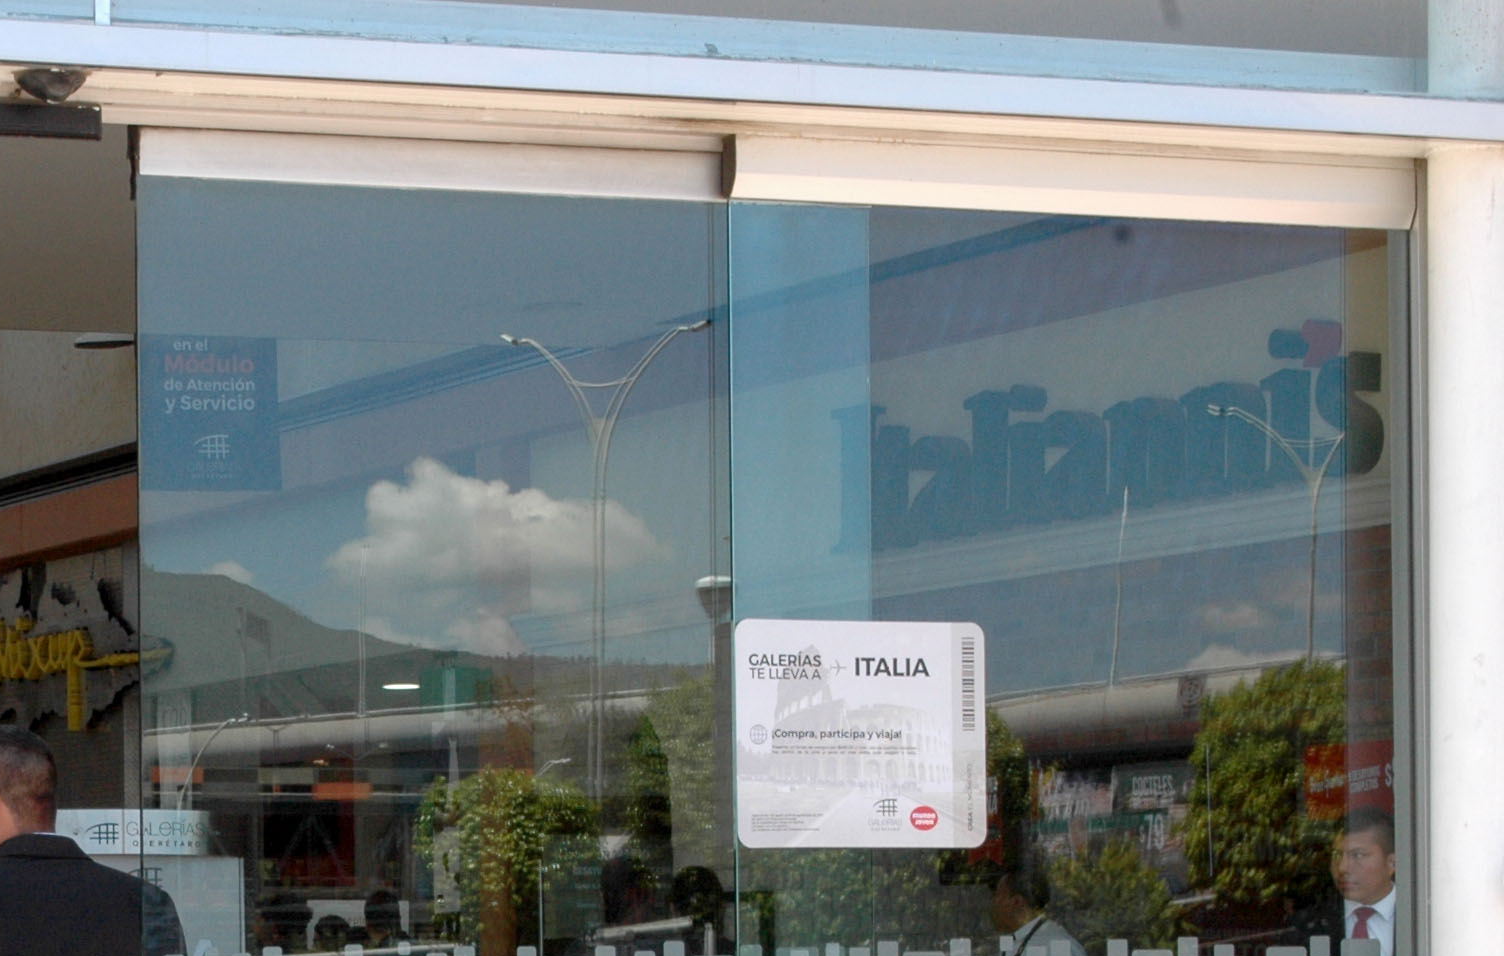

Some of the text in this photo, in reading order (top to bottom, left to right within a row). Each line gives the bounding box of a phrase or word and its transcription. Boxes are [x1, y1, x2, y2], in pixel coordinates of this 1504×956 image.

[173, 338, 209, 351] en el
[163, 354, 256, 374] Módulo
[163, 378, 256, 392] de Atención
[164, 394, 256, 414] y Servicio
[748, 650, 930, 678] GALERÍAS ITALIA
[749, 667, 822, 681] TE LLEVA A
[819, 729, 866, 740] participa
[866, 730, 874, 740] y
[874, 728, 902, 740] viaja!
[126, 818, 207, 837] GALERÍAS
[132, 839, 201, 848] QERÉTARO
